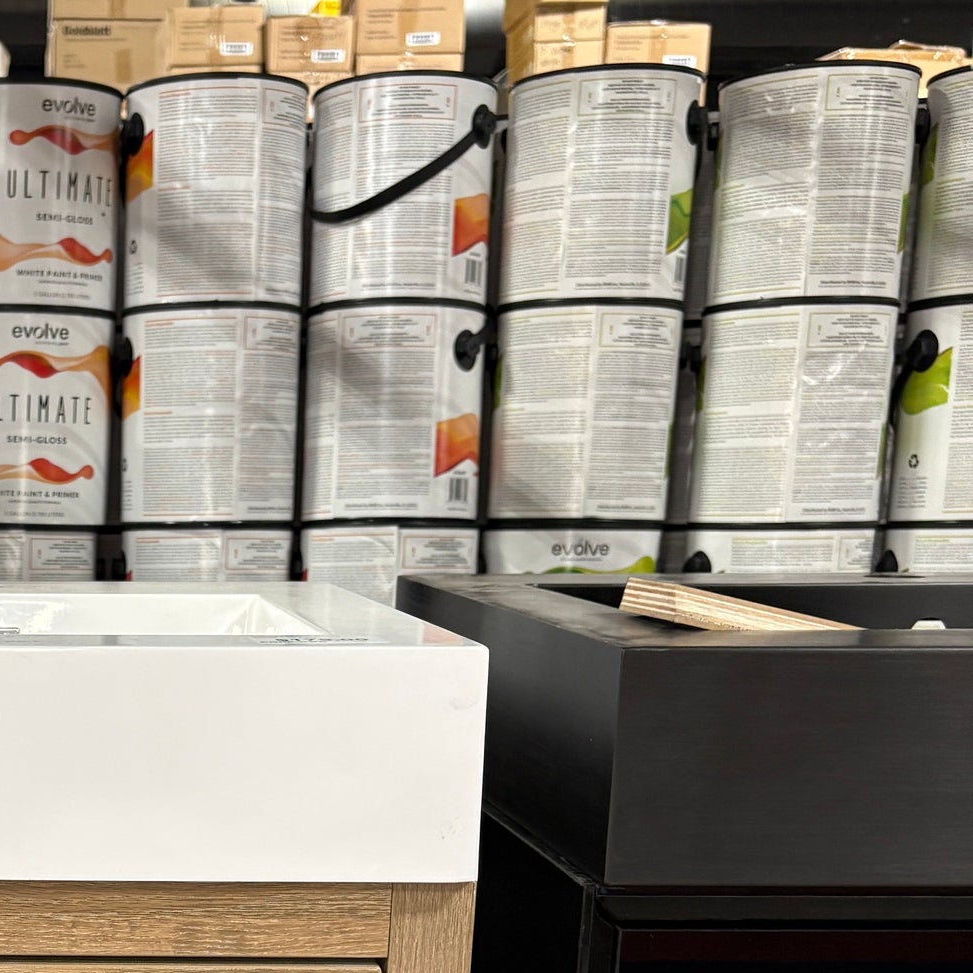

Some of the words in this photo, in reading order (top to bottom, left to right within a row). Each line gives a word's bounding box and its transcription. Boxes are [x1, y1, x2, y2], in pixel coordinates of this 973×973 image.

[42, 97, 96, 117] evolve
[7, 169, 112, 208] ULTIMATE
[36, 213, 94, 226] SEMI-GLOSS
[12, 323, 70, 341] evolve
[6, 435, 68, 445] SEMI-GLOSS
[551, 540, 610, 557] evolve
